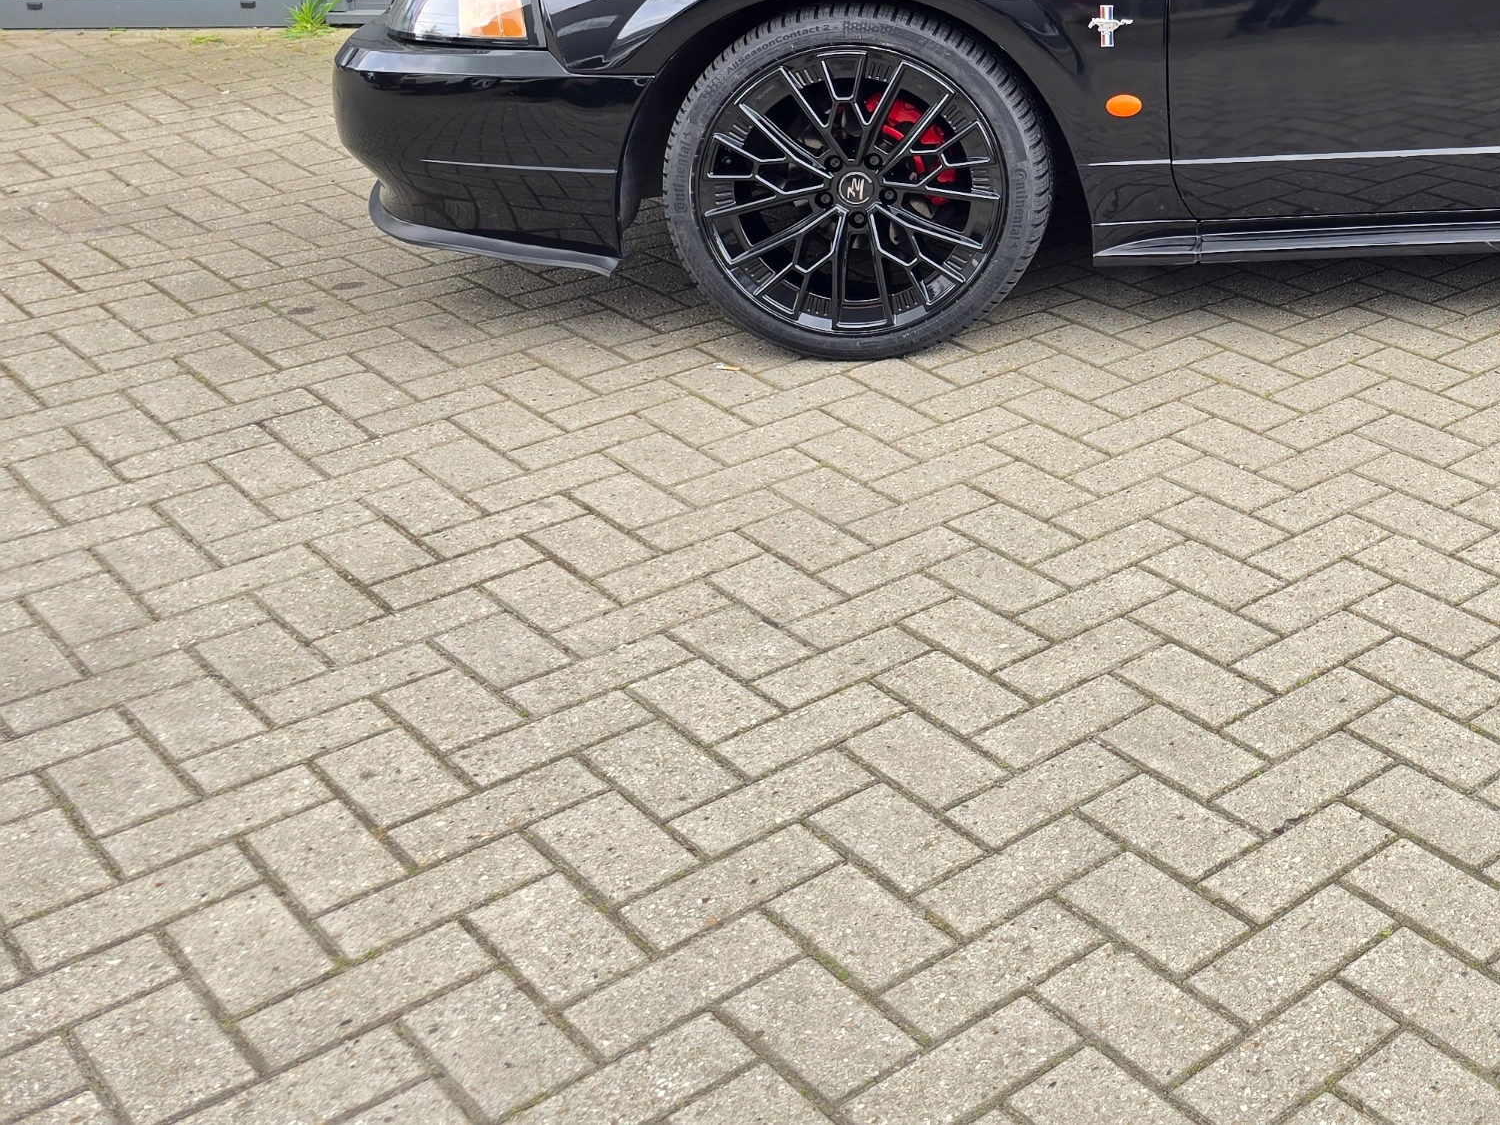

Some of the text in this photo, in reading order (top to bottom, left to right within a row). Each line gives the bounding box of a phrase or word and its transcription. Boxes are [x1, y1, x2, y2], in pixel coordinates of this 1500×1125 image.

[726, 26, 820, 75] AllSeasonContact
[673, 140, 692, 214] Continental
[1008, 168, 1028, 241] Continental
